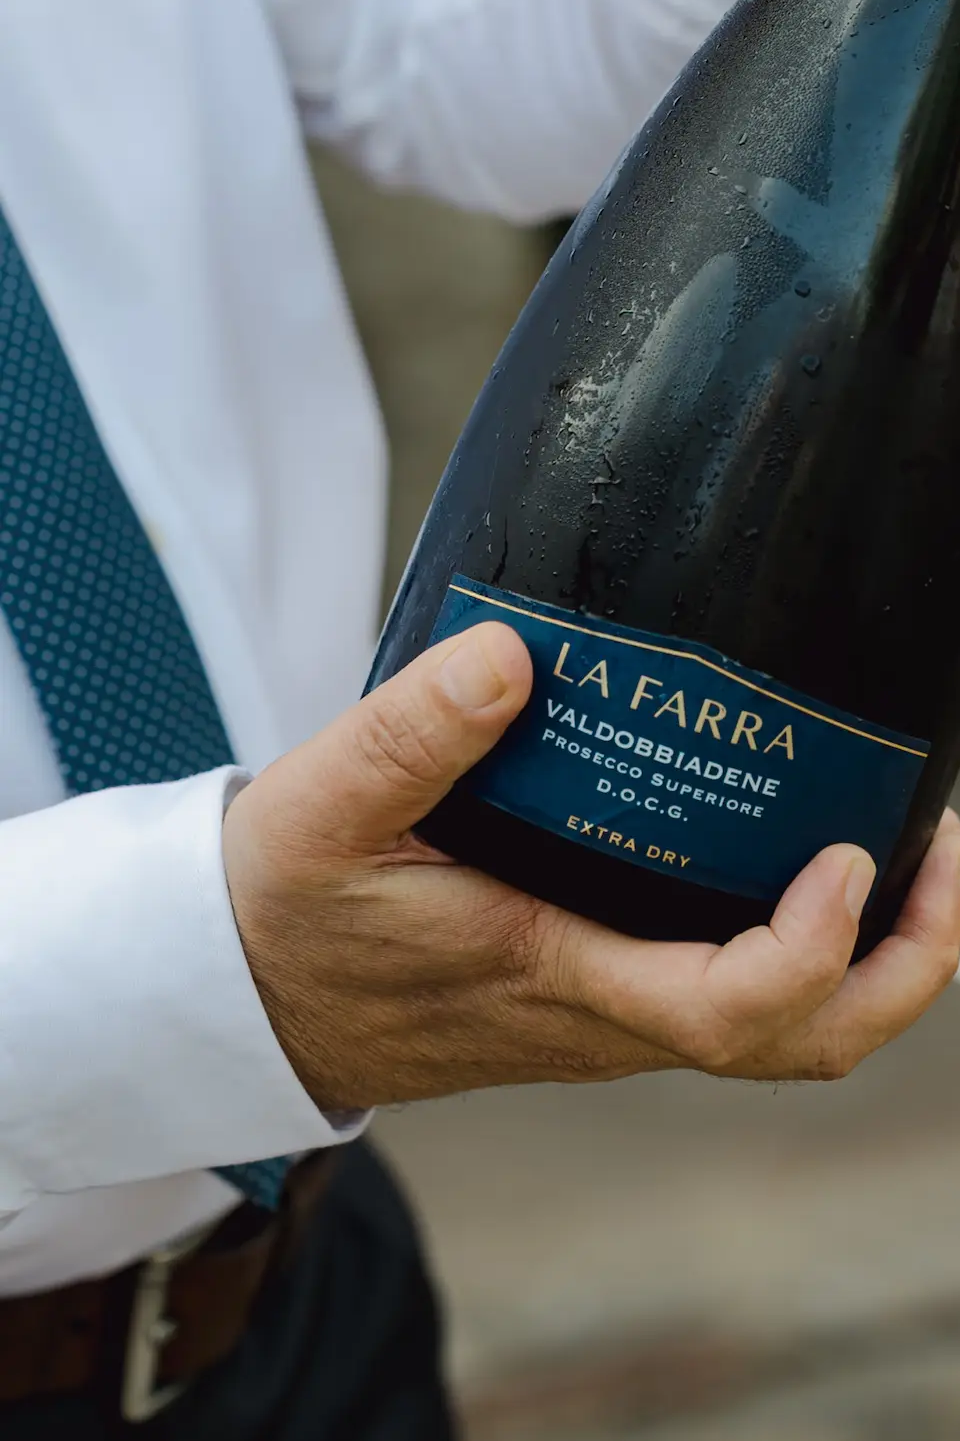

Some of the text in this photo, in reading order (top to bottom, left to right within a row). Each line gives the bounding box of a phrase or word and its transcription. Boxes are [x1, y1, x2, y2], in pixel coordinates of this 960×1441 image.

[553, 641, 795, 761] LA FARRA
[541, 728, 765, 819] PROSECCO SUPERIORE
[546, 698, 781, 798] VALDOBBIADENE
[565, 815, 691, 868] EXTRA DRY
[595, 778, 689, 822] D.O.C.G.
